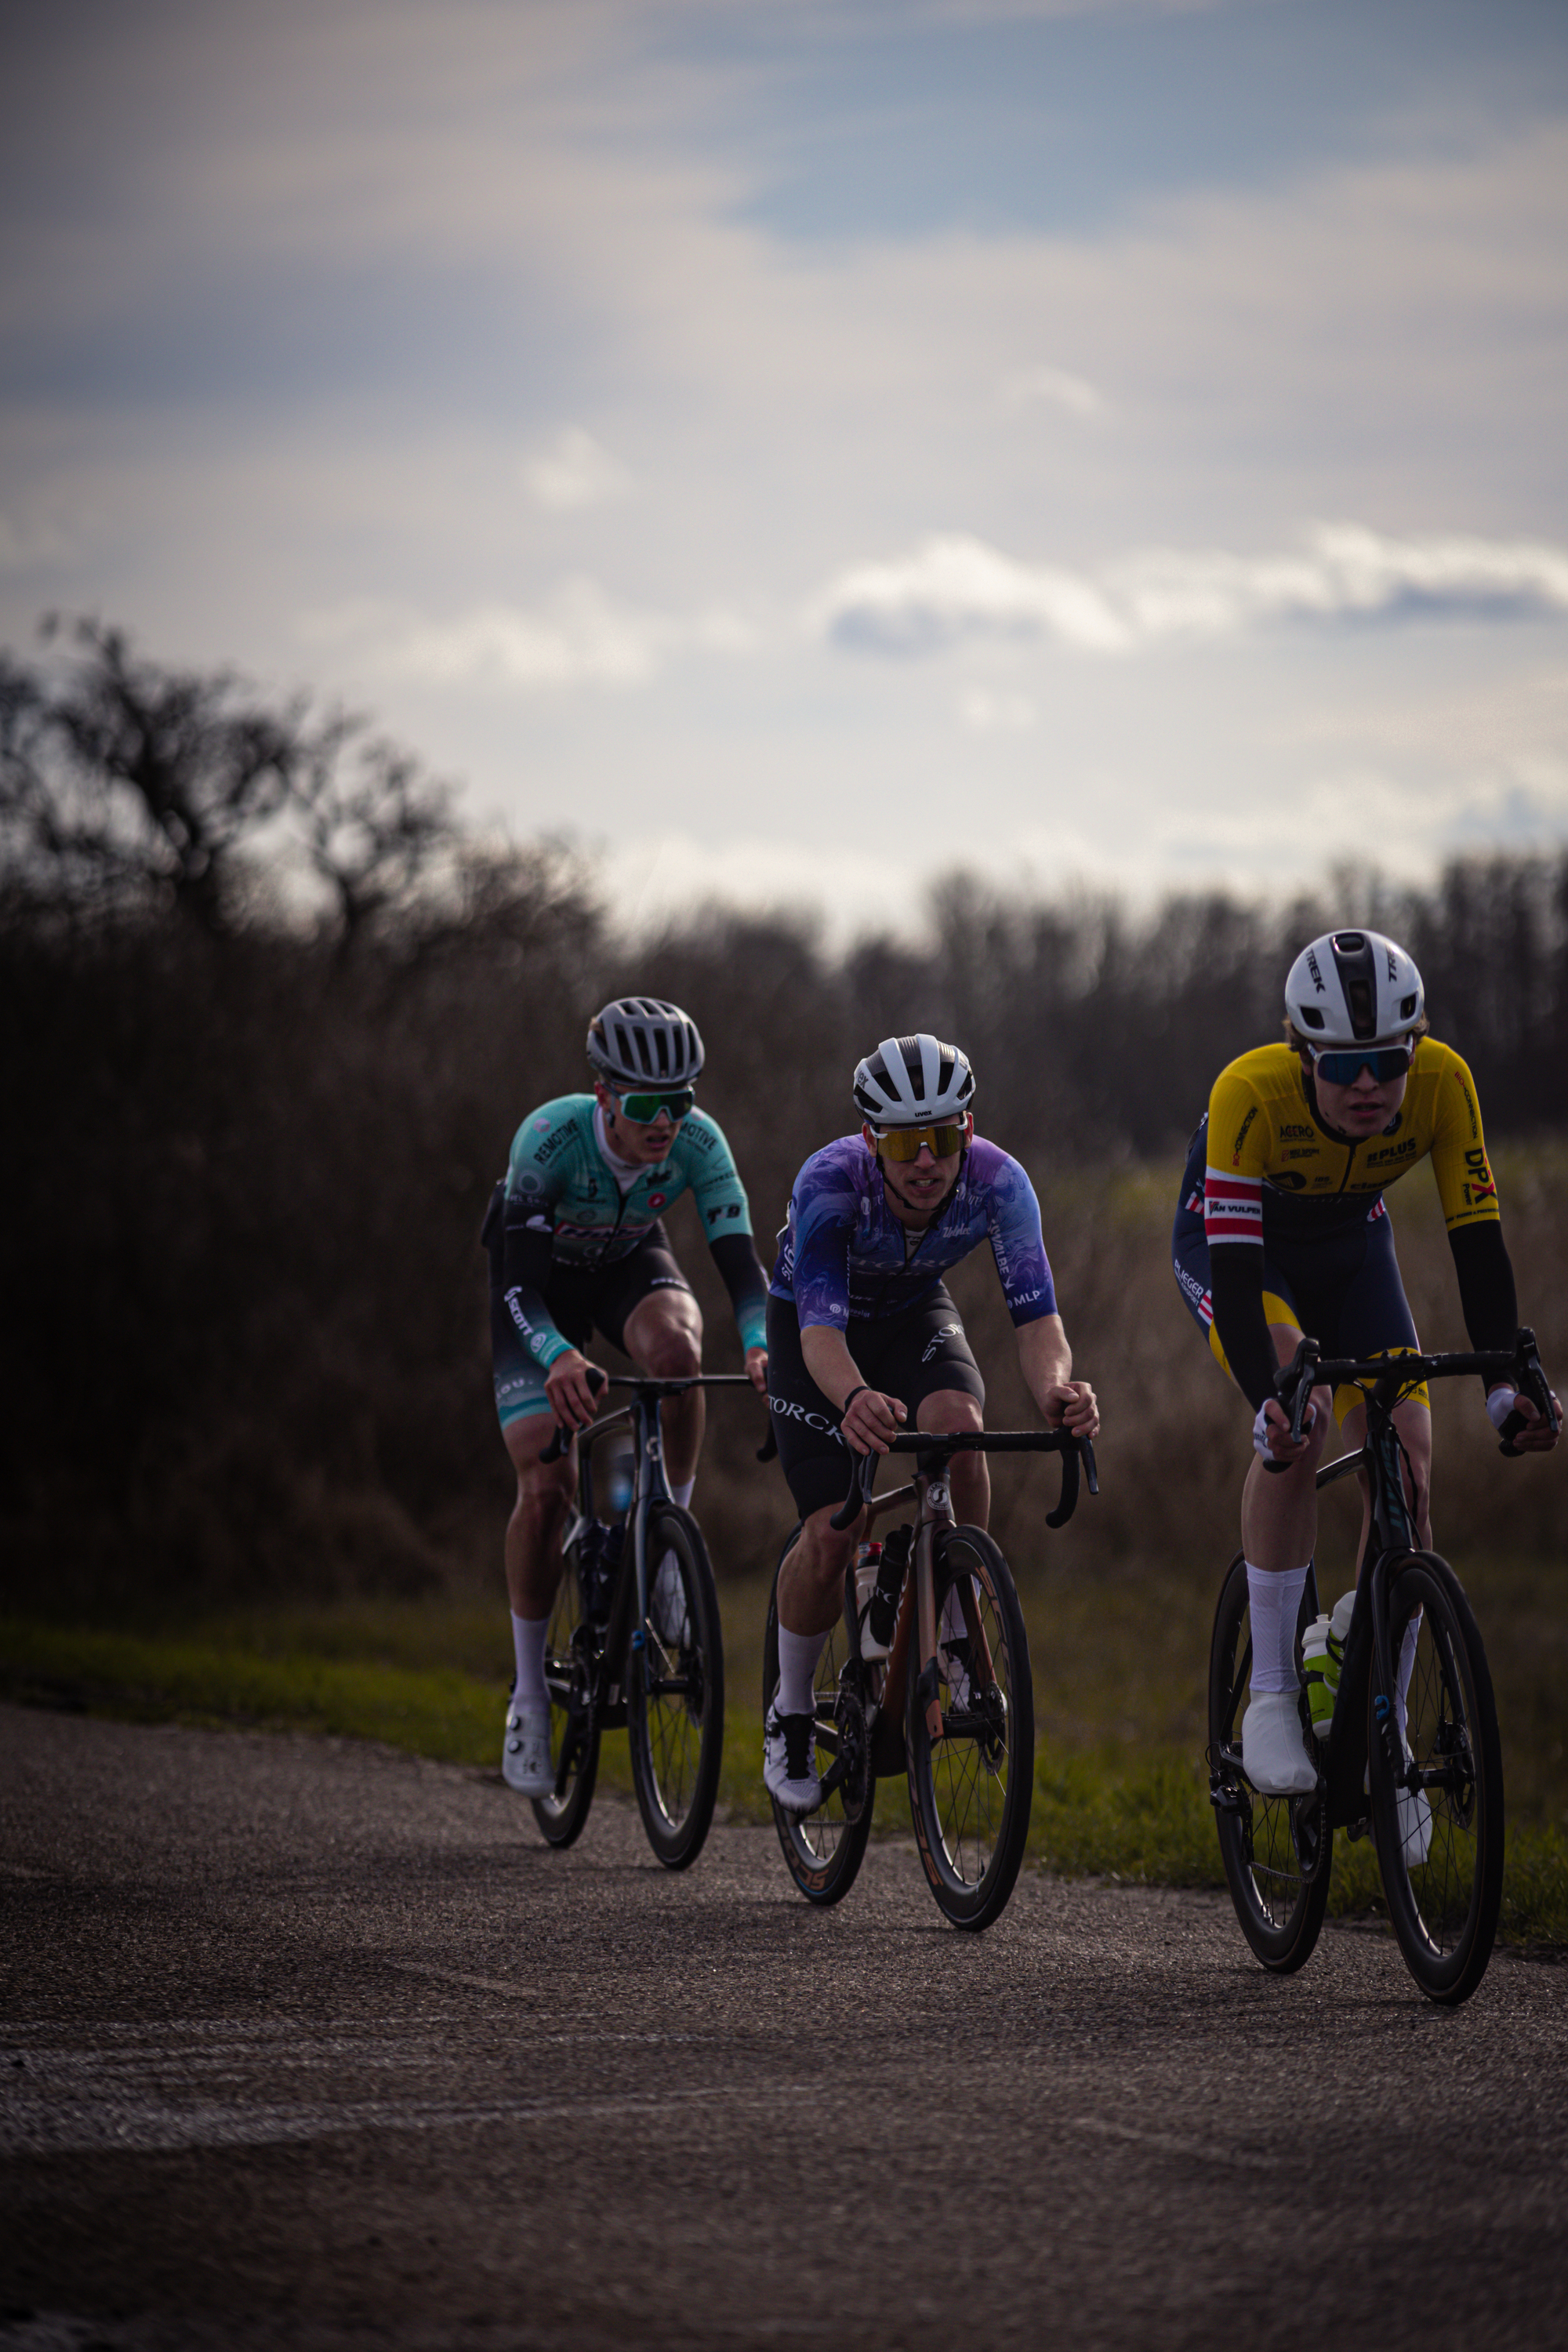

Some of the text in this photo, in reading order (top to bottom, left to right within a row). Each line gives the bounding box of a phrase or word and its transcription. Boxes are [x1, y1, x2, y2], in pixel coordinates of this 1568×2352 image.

[1306, 948, 1326, 993] TREK
[1385, 942, 1398, 982] TRE
[1280, 1125, 1314, 1138] ACERO
[1379, 1137, 1416, 1160] PLUS
[1463, 1182, 1472, 1206] Power
[1465, 1147, 1497, 1205] DPX
[1209, 1201, 1225, 1215] VAN
[1014, 1290, 1040, 1306] MLP
[1174, 1258, 1204, 1299] PLIEGER
[508, 1296, 534, 1336] SCOTT
[768, 1395, 844, 1447] TORCK
